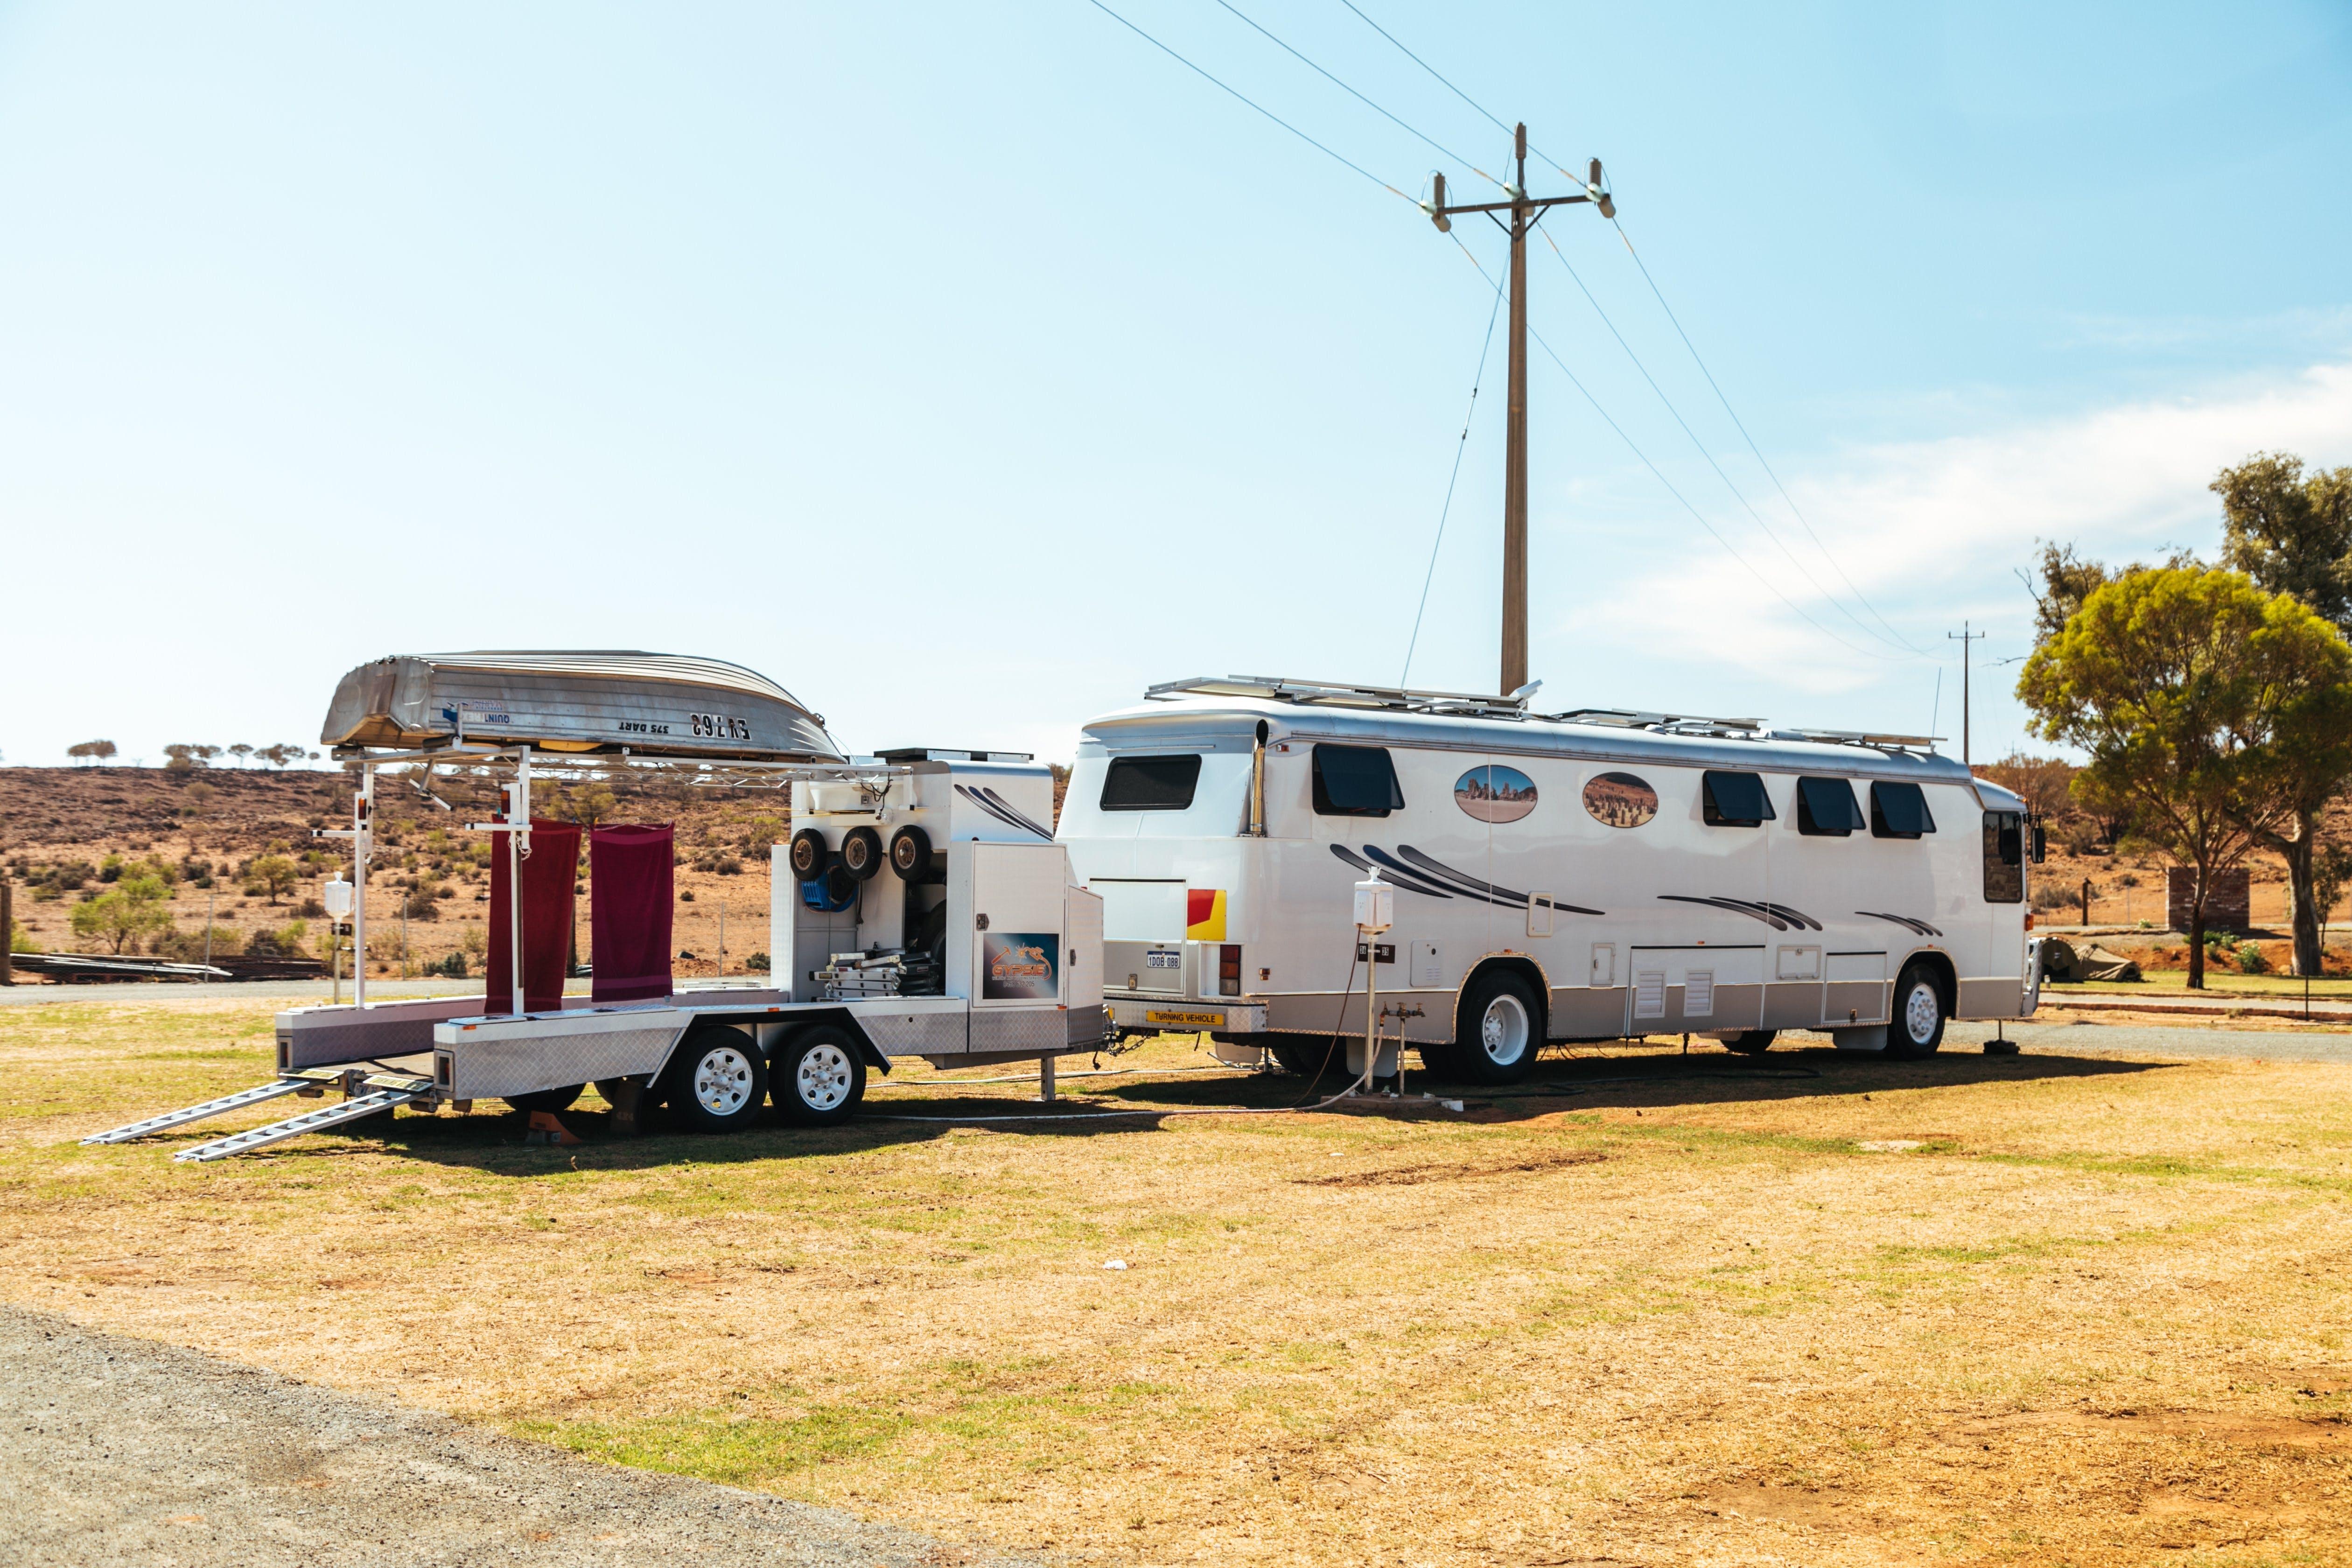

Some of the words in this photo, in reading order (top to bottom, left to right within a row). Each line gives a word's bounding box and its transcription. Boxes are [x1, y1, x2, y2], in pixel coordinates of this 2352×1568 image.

[619, 722, 647, 732] DART
[651, 724, 669, 734] 375
[993, 964, 1045, 976] GYPSIE
[1155, 1013, 1183, 1021] TURNING
